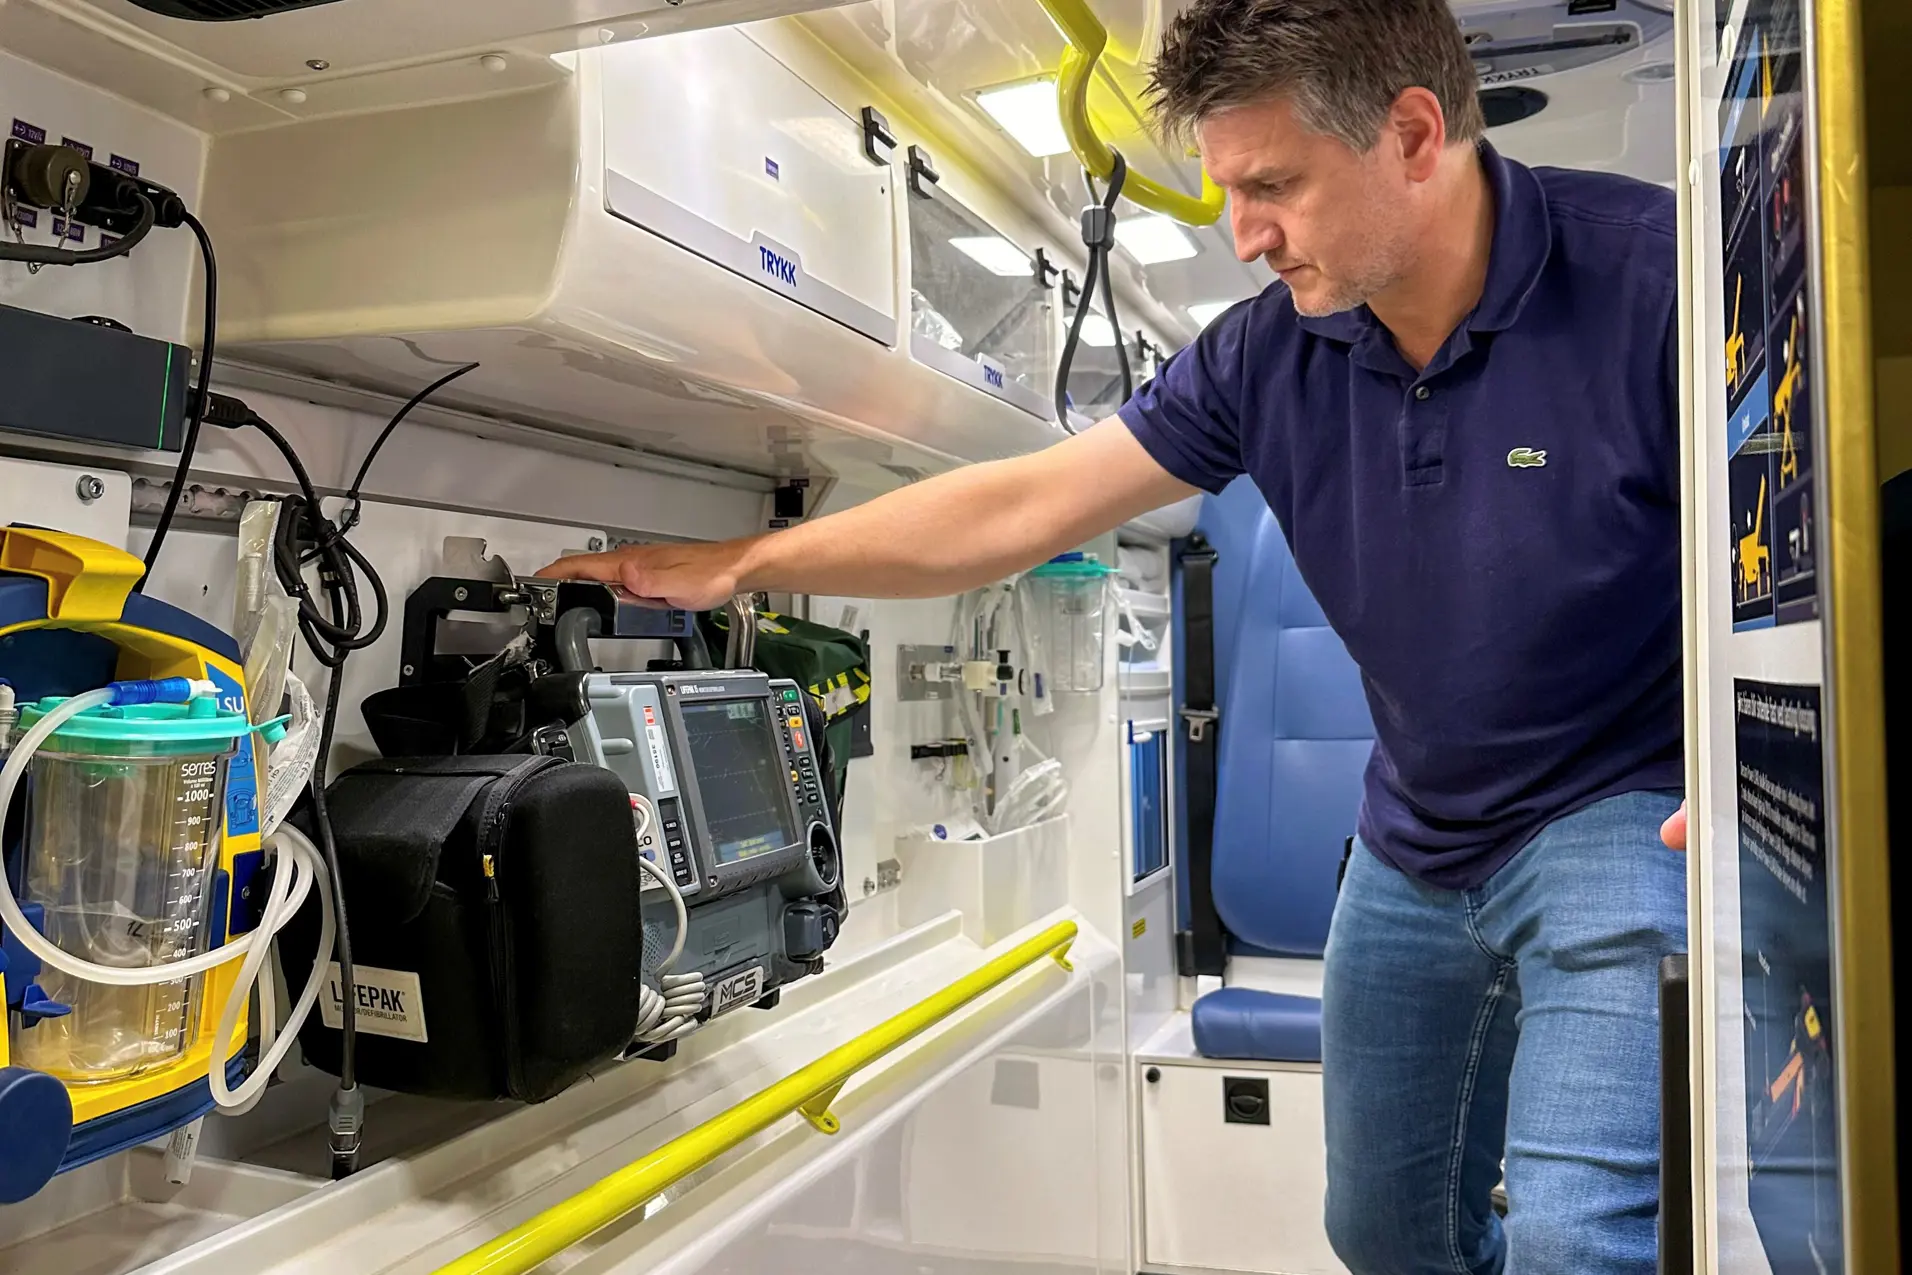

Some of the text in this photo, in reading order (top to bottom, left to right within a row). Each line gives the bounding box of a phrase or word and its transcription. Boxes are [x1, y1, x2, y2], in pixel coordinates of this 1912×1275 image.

[760, 245, 796, 288] TRYKK
[983, 364, 1003, 389] TRYKK
[181, 761, 216, 777] serres
[184, 788, 209, 803] 1000
[187, 816, 201, 826] 900
[184, 842, 198, 852] 800
[182, 868, 195, 878] 700
[179, 894, 193, 904] 600
[174, 918, 192, 931] 500
[173, 947, 187, 958] 400
[720, 971, 756, 1005] MCS
[331, 980, 405, 1013] LEPAK
[167, 1001, 180, 1013] 200
[165, 1027, 178, 1039] 100
